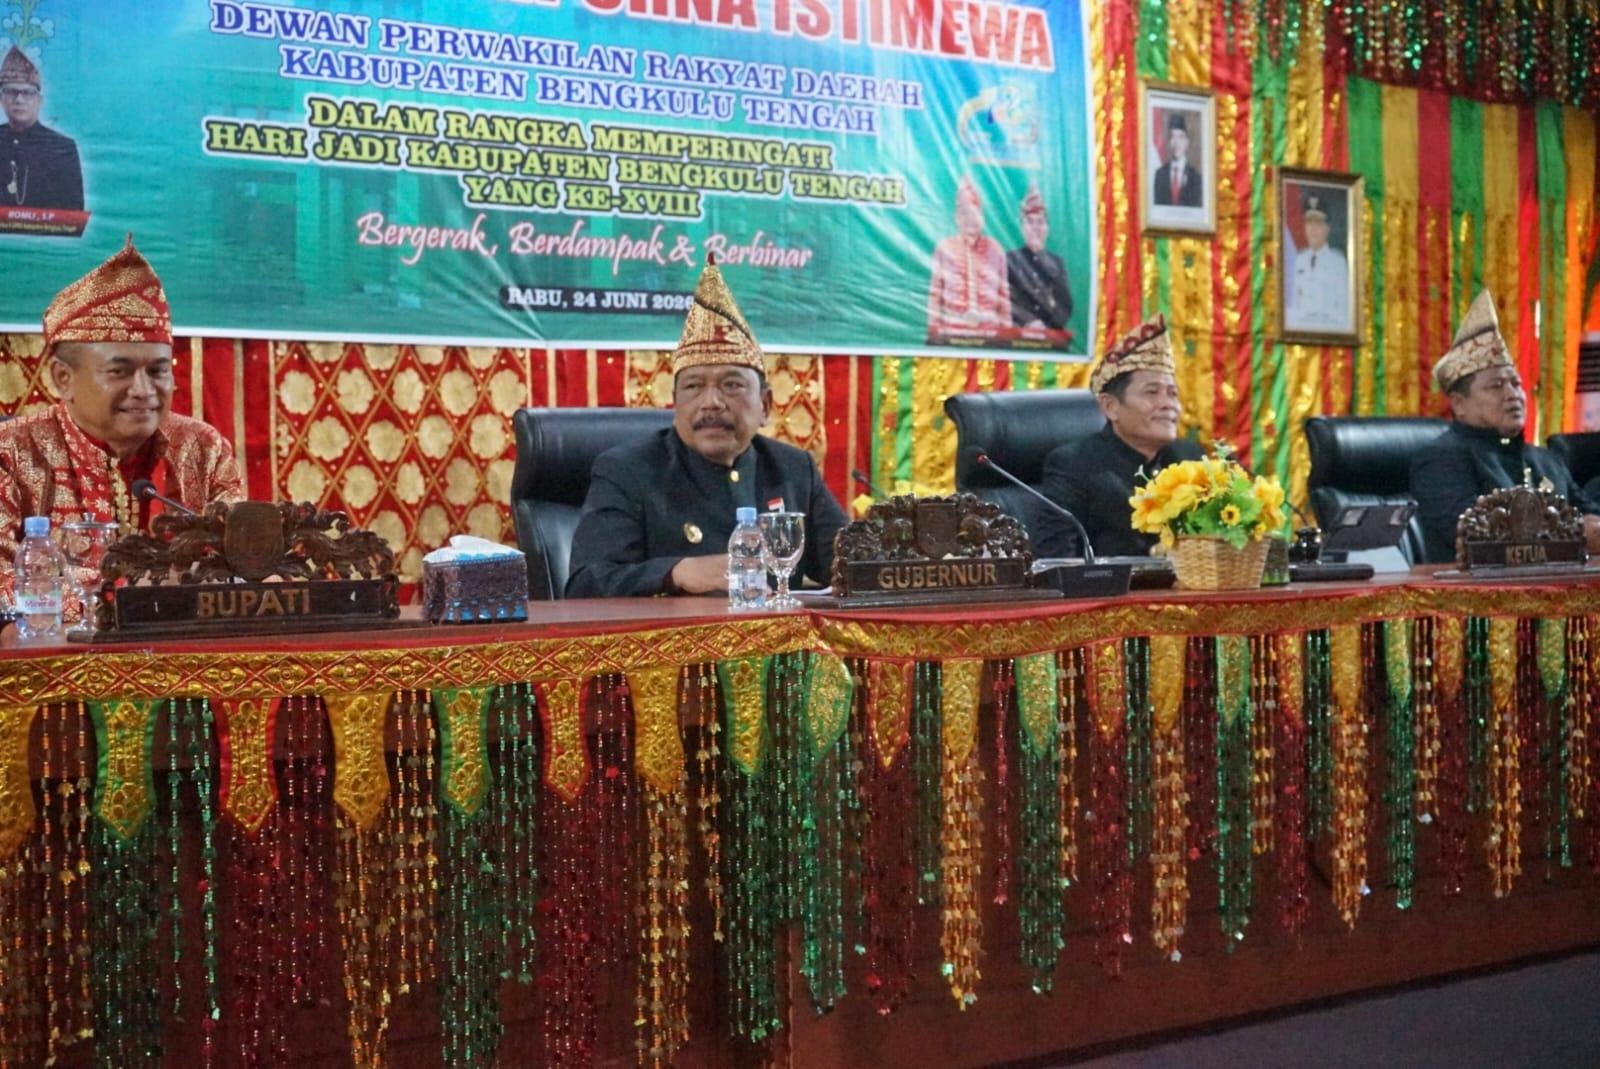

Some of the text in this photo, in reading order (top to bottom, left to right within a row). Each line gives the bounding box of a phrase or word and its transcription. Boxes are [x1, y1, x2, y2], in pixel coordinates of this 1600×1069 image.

[213, 2, 921, 106] DEWAN PERWAKILAN RAKYAT DAERAH
[774, 0, 1053, 68] ISTIMEWA
[281, 48, 876, 132] KABUPATEN BENGKULU TENGAH
[206, 121, 906, 204] HARI JADI KABUPATEN BENGKULU TENGAH
[309, 98, 833, 170] DALAM RANGKA MEMPERINGATI
[464, 175, 702, 217] YANG KE-XVIII
[356, 212, 813, 276] Bergerak, Berdampak & Berbinar
[507, 286, 568, 308] RABU,
[572, 291, 597, 306] 24
[601, 291, 649, 309] JUNI
[877, 563, 998, 591] GUBERNUR
[1505, 544, 1549, 564] KETUA
[196, 587, 311, 618] BUPATI
